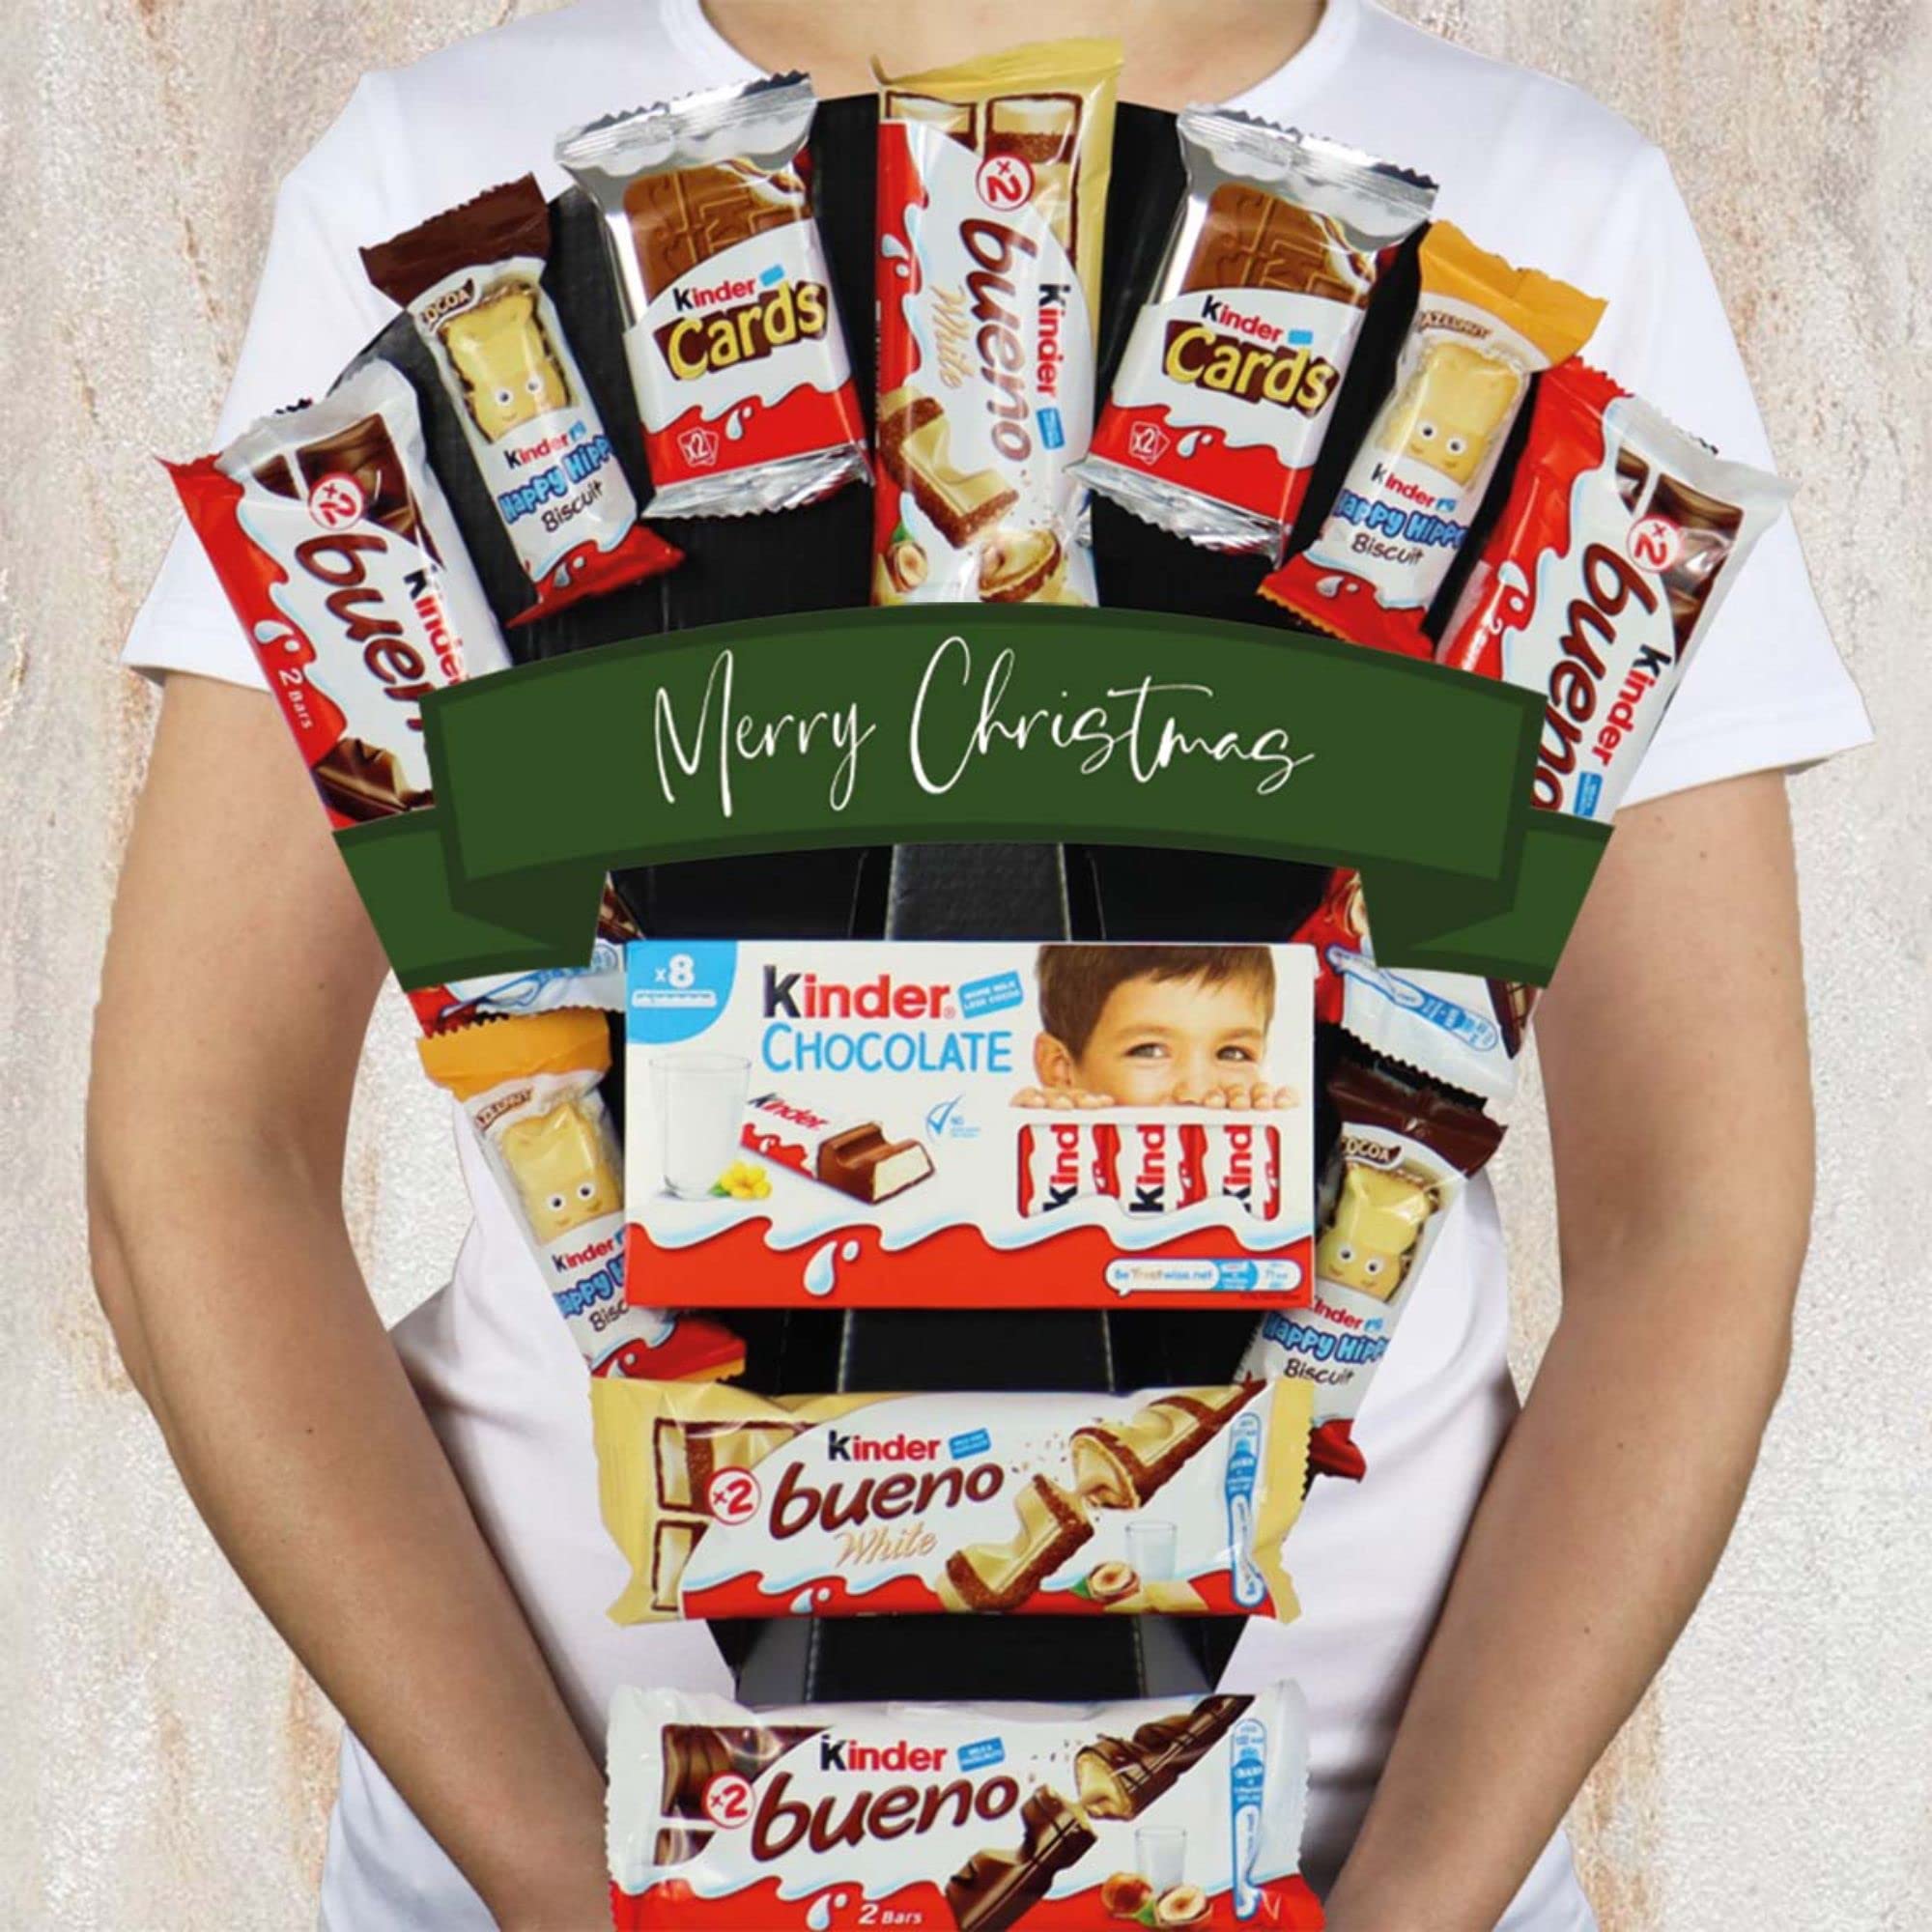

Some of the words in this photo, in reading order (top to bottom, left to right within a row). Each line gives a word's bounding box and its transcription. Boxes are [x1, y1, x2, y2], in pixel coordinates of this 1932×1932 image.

[419, 289, 470, 331] OCOA
[668, 281, 826, 380] Cards
[930, 284, 974, 391] White
[959, 218, 1037, 462] bueno
[1165, 327, 1337, 412] Cards
[561, 434, 611, 483] Hipp
[541, 479, 603, 532] Biscuit
[1334, 489, 1407, 538] appy
[1351, 533, 1425, 565] Biscuit
[295, 534, 435, 731] buen
[1530, 543, 1659, 811] bueno
[654, 649, 876, 818] Merry
[910, 635, 1316, 796] Christmas
[761, 1022, 1012, 1072] CHOCOLATE
[553, 1269, 614, 1320] appy
[589, 1299, 630, 1332] Bisc
[1312, 1296, 1363, 1329] inder
[1284, 1358, 1354, 1385] Biscuit
[1334, 1332, 1391, 1364] Hipp
[769, 1463, 1004, 1540] bueno
[834, 1520, 938, 1567] White
[751, 1772, 1019, 1861] bueno
[858, 1903, 879, 1924] 2
